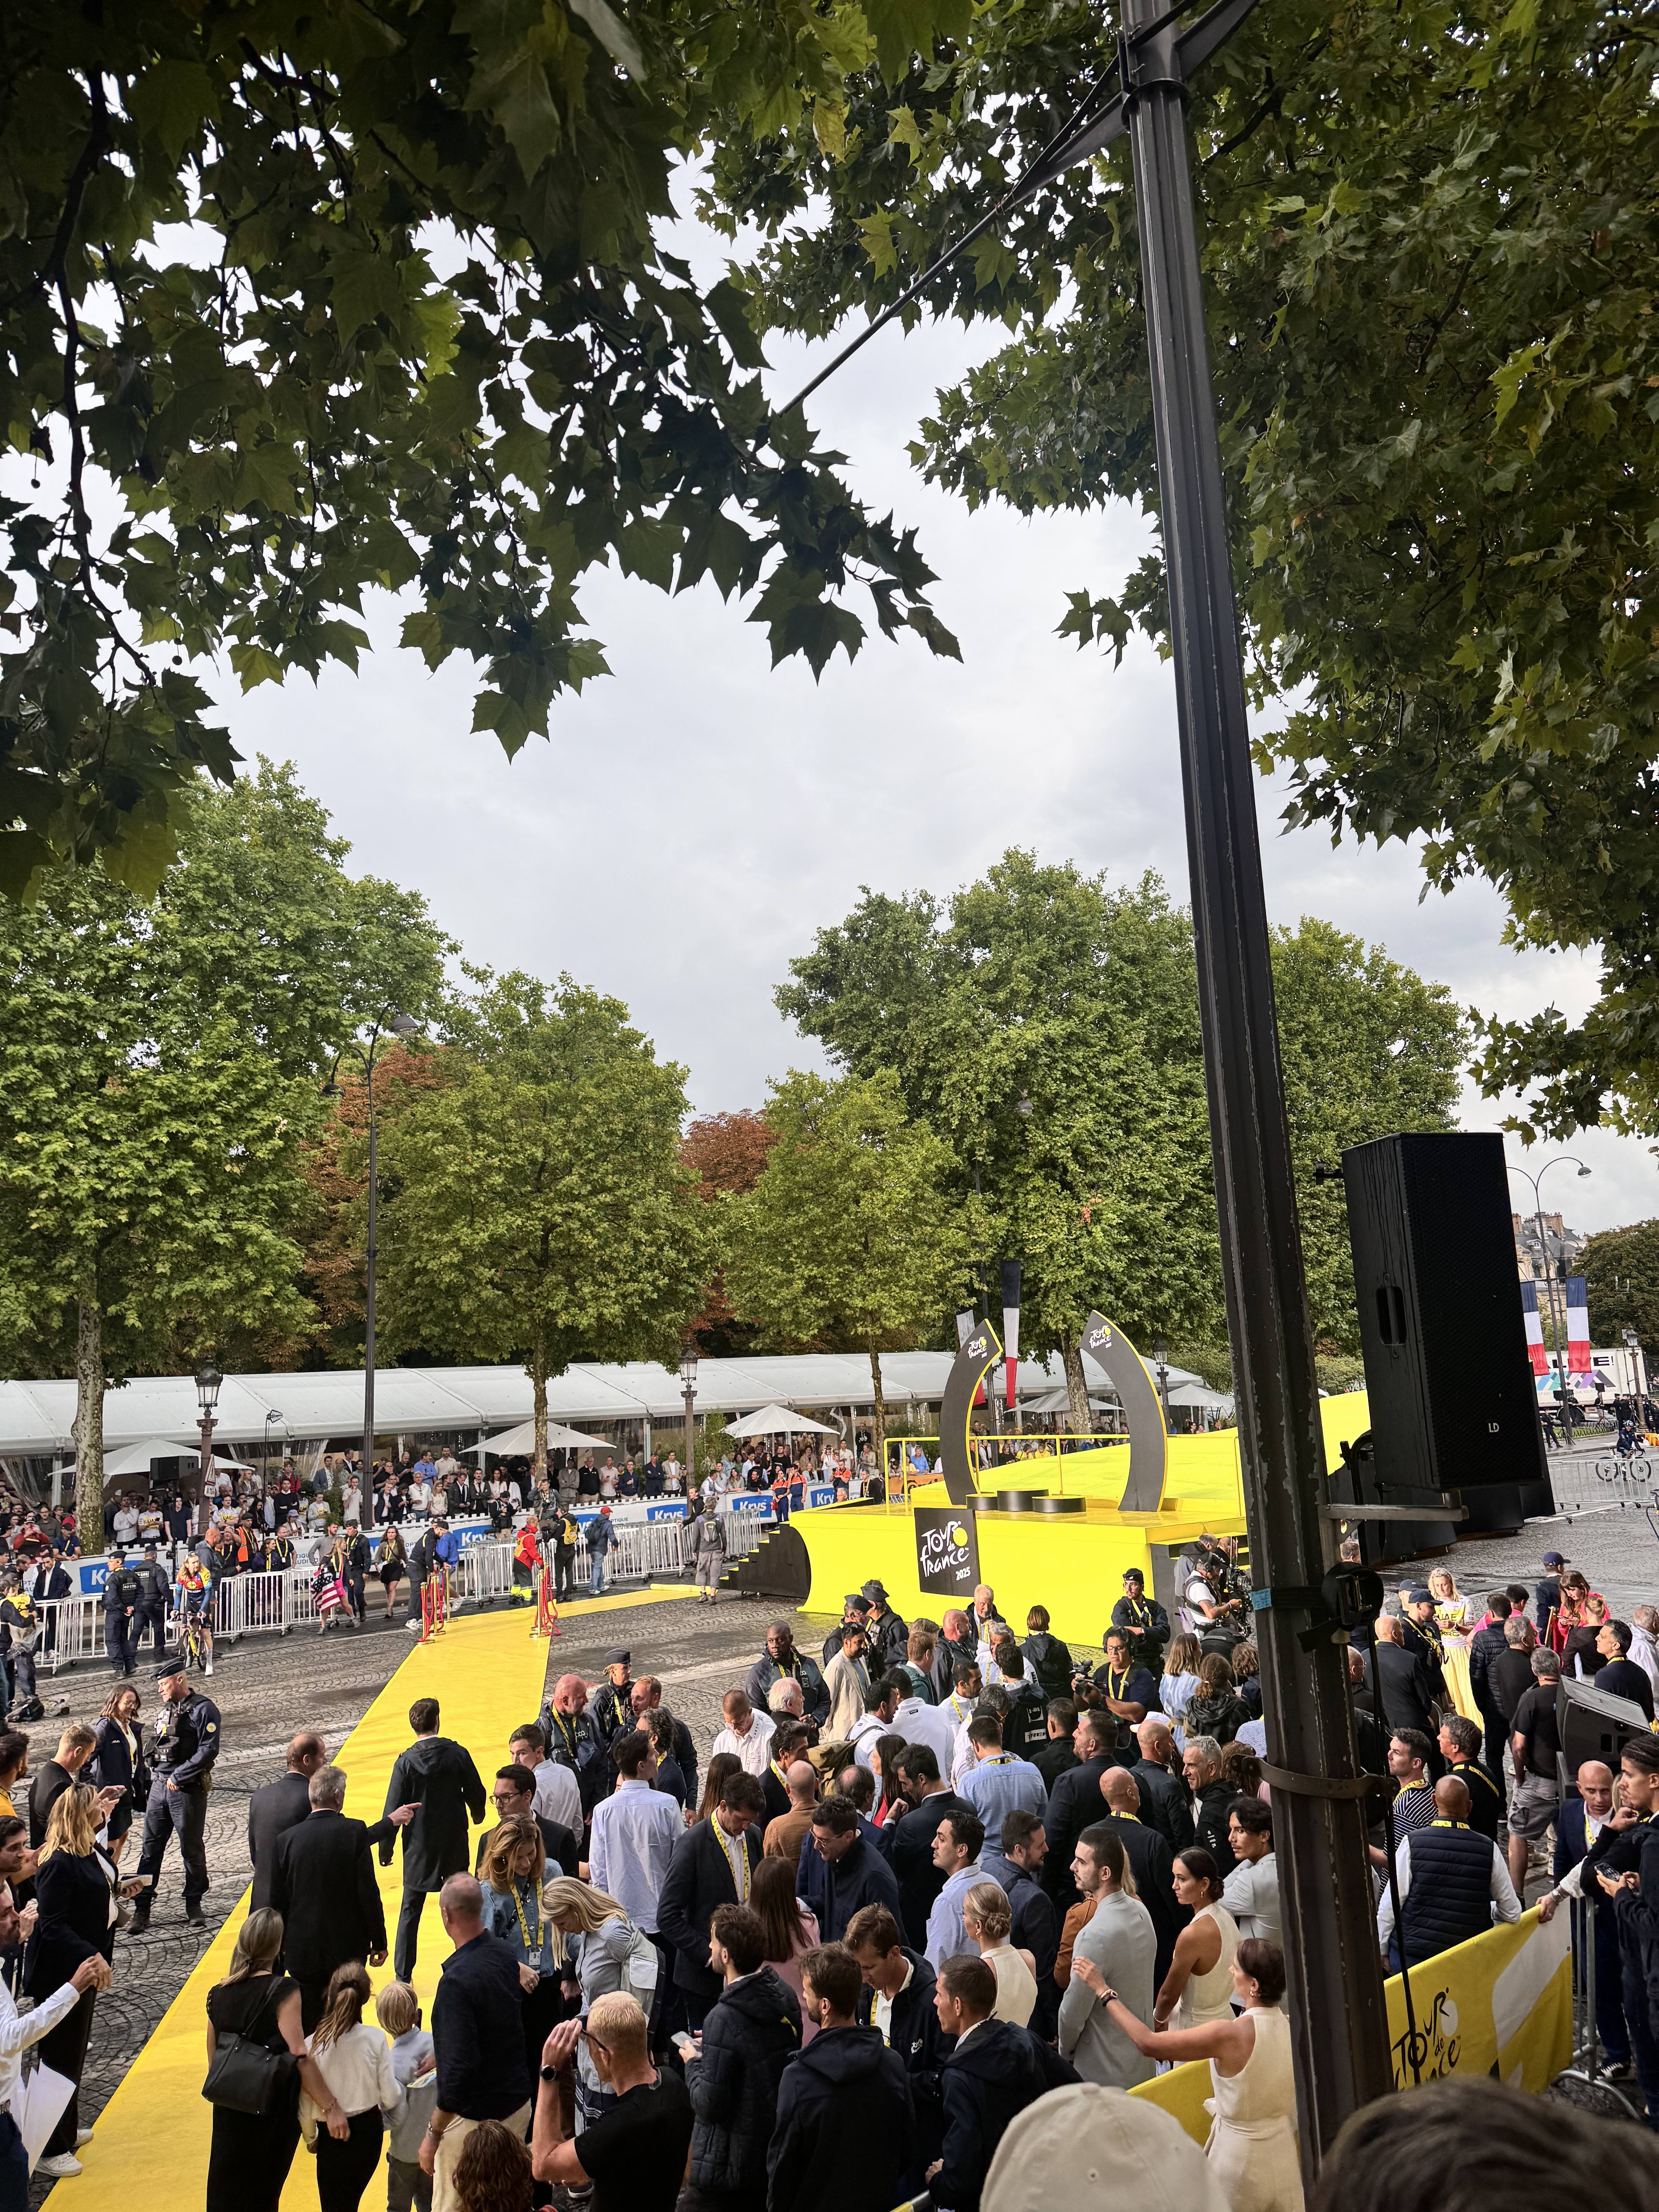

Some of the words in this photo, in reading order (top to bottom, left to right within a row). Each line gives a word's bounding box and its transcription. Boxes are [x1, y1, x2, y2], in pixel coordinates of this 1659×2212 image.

[1489, 1423, 1499, 1432] LD
[817, 1493, 834, 1505] Kry
[948, 1541, 956, 1551] de
[956, 1566, 971, 1581] 2025
[1435, 2035, 1444, 2057] de
